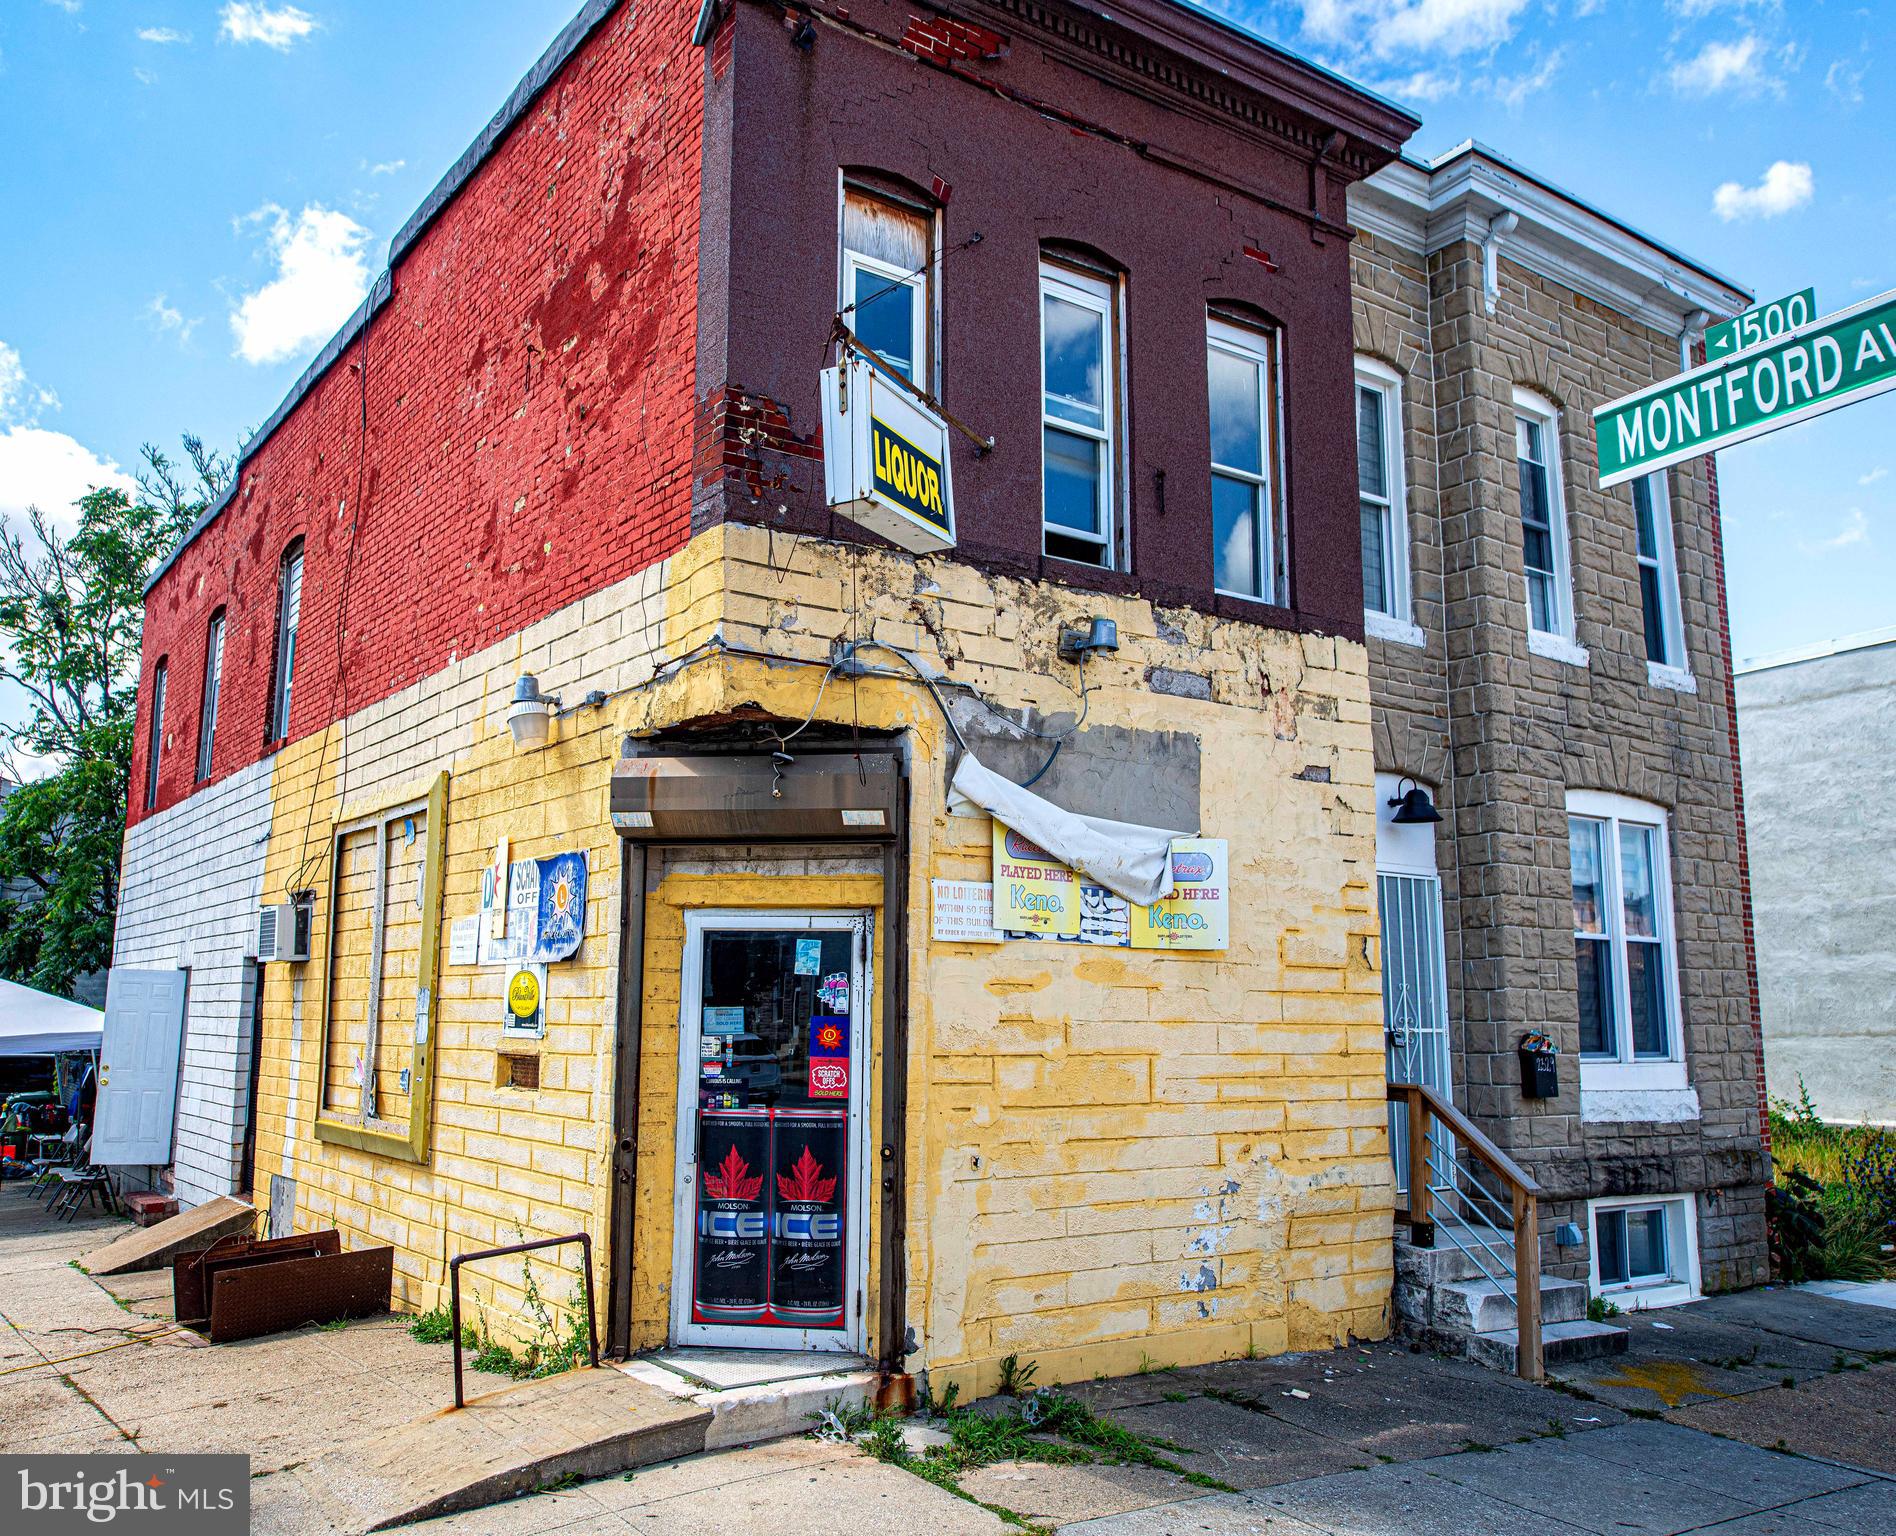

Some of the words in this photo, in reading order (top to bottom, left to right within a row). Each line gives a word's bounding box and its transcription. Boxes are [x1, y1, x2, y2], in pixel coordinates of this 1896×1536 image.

[1732, 295, 1808, 353] 1500
[1616, 335, 1843, 464] MONTFORD
[873, 429, 944, 515] LIQUOR
[1001, 864, 1042, 880] PLAYED
[1044, 868, 1074, 883] HERE
[937, 885, 950, 899] NO
[953, 886, 993, 902] LOITERIN
[1183, 888, 1220, 900] HERE
[937, 903, 964, 913] WITHIN
[966, 904, 977, 914] 50
[979, 905, 993, 915] FEE
[934, 915, 944, 925] OF
[947, 916, 964, 926] THIS
[818, 1070, 841, 1078] SCRATCH
[822, 1077, 836, 1085] OFFS
[791, 1204, 822, 1212] MOLSON
[702, 1210, 763, 1238] ICE
[775, 1212, 837, 1240] ICE
